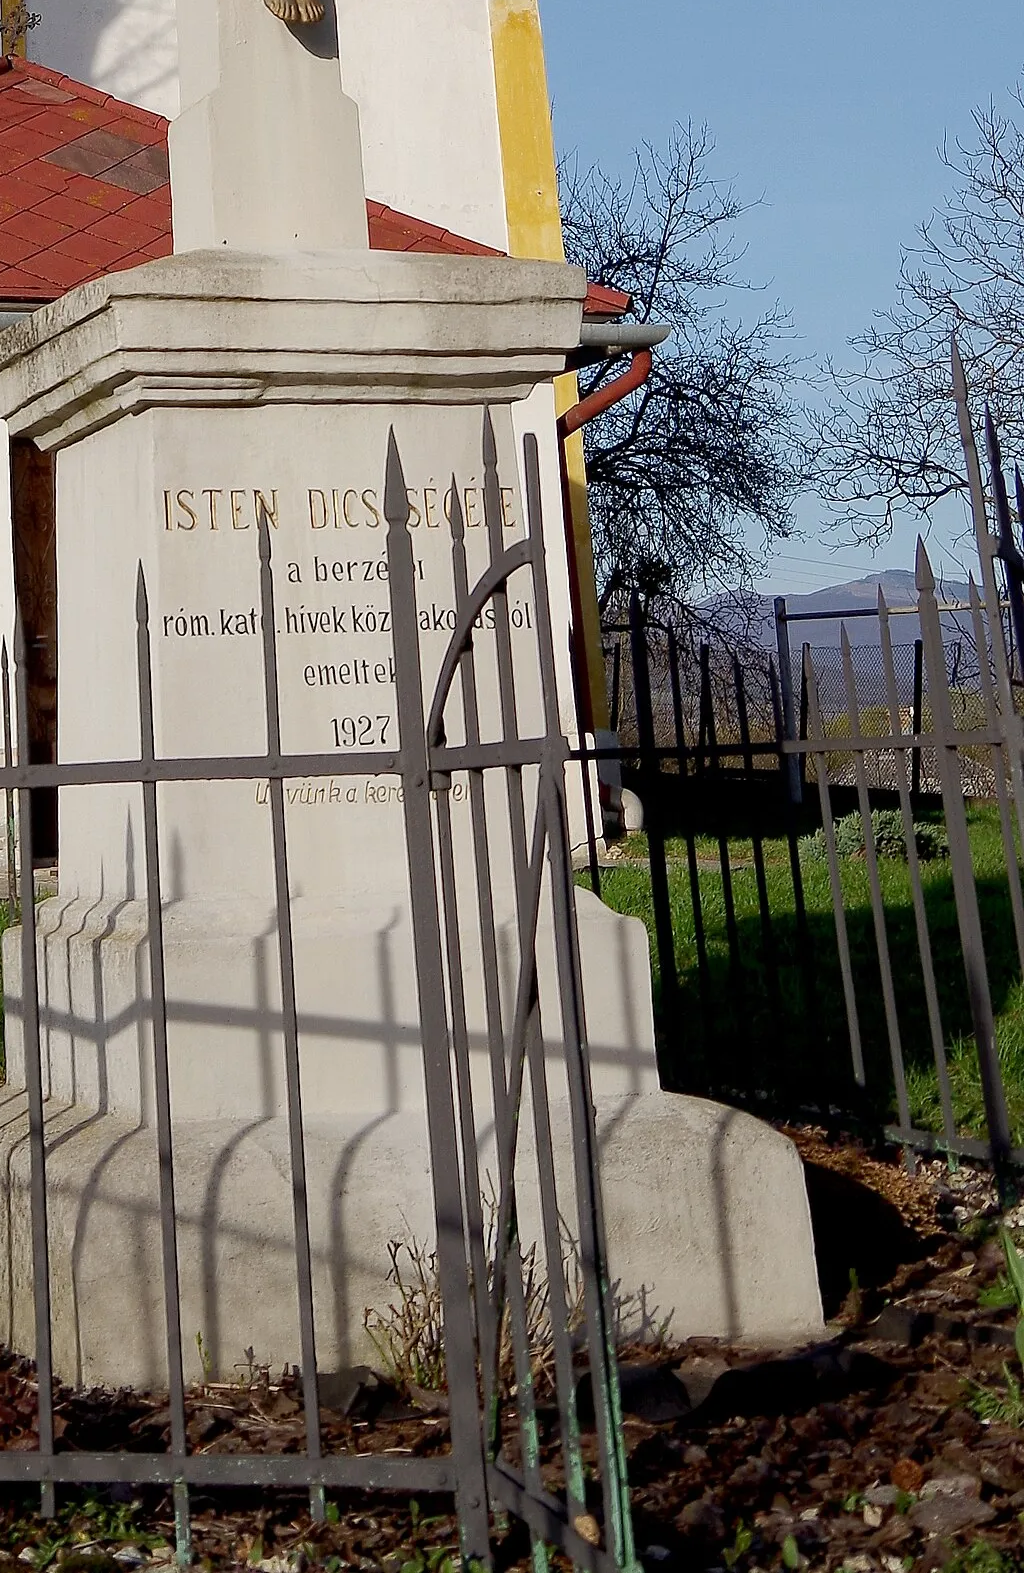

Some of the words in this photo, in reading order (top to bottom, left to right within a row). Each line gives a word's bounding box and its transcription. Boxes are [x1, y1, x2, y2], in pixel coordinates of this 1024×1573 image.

[162, 488, 280, 531] ISTEN
[286, 561, 303, 584] a
[162, 607, 215, 637] róm.
[284, 604, 347, 635] hívek
[330, 714, 391, 748] 1927
